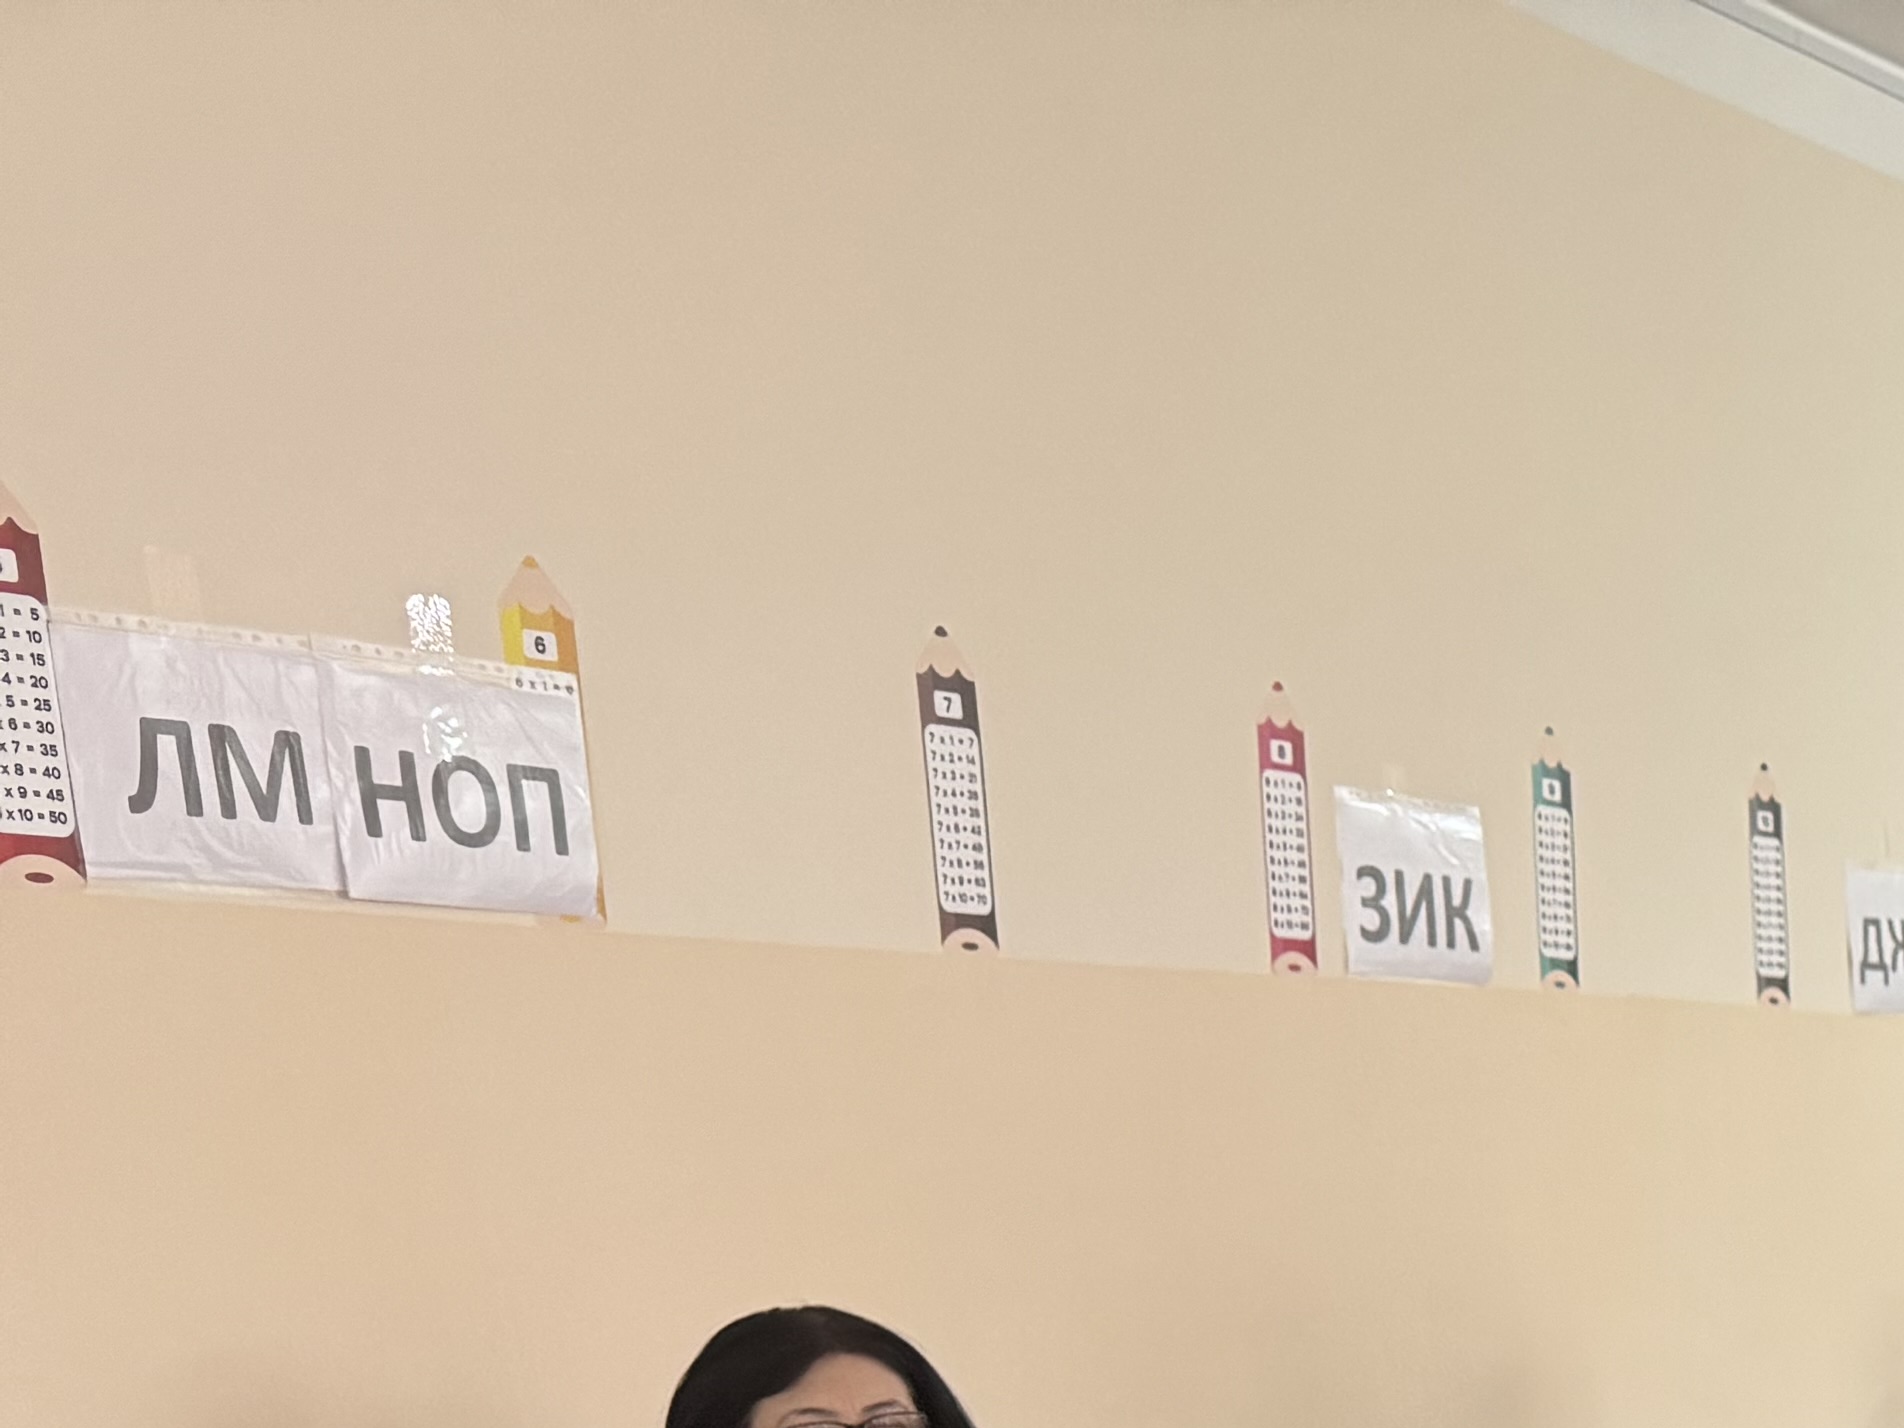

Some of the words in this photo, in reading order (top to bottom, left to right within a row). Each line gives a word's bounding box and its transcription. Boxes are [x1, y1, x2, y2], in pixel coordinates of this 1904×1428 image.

[30, 607, 40, 621] 5
[26, 630, 42, 643] 10
[534, 635, 546, 654] 6
[0, 649, 10, 662] 3
[30, 652, 46, 666] 15
[1, 672, 12, 685] 4
[29, 675, 48, 689] 20
[6, 695, 15, 707] 5
[34, 698, 52, 712] 25
[943, 696, 952, 713] 7
[8, 717, 18, 731] 6
[36, 720, 55, 734] 30
[12, 740, 20, 754] 7
[40, 743, 58, 757] 35
[14, 763, 24, 776] 8
[42, 766, 61, 780] 40
[127, 716, 314, 826] ЛМ
[17, 786, 28, 799] 9
[46, 789, 65, 802] 45
[353, 745, 570, 856] НОП
[17, 808, 34, 822] 10
[48, 810, 68, 825] 50
[1355, 864, 1480, 953] ЗИК
